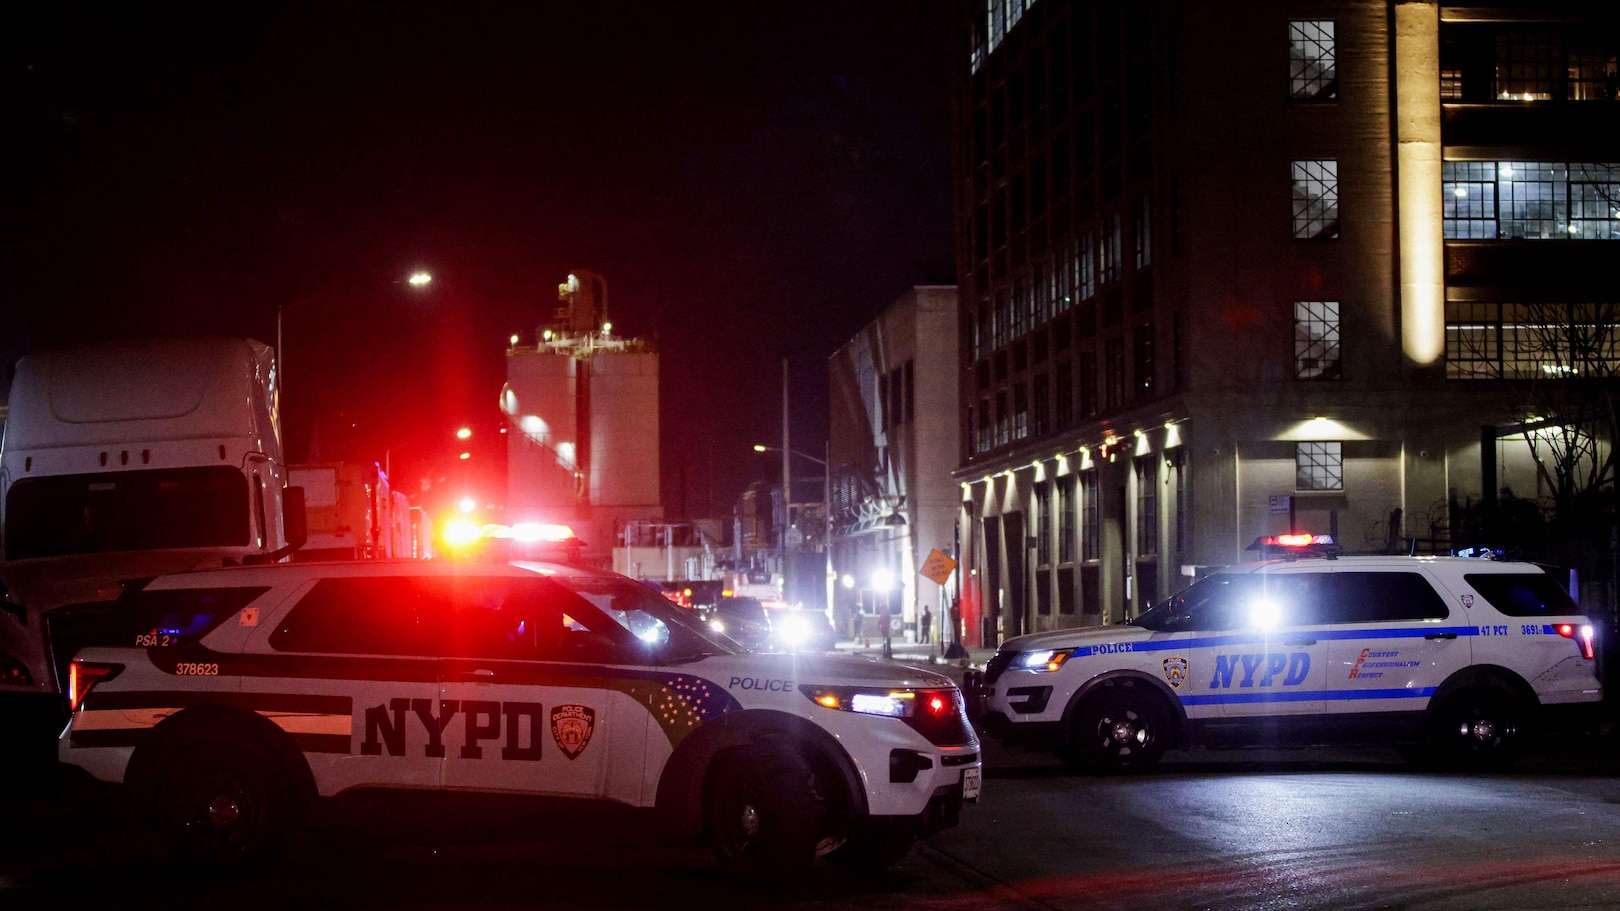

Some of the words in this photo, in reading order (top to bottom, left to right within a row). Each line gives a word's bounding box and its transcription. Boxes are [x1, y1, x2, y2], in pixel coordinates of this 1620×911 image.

[1481, 626, 1490, 635] 47
[1494, 625, 1507, 635] PCT
[1521, 625, 1539, 635] 3691
[135, 634, 158, 647] PSA
[161, 635, 170, 647] 2
[1092, 643, 1133, 655] POLICE
[176, 662, 219, 676] 378623
[1209, 652, 1311, 689] NYPD
[729, 677, 795, 692] POLICE
[552, 711, 593, 722] DEPARTMENT
[360, 698, 543, 761] NYPD
